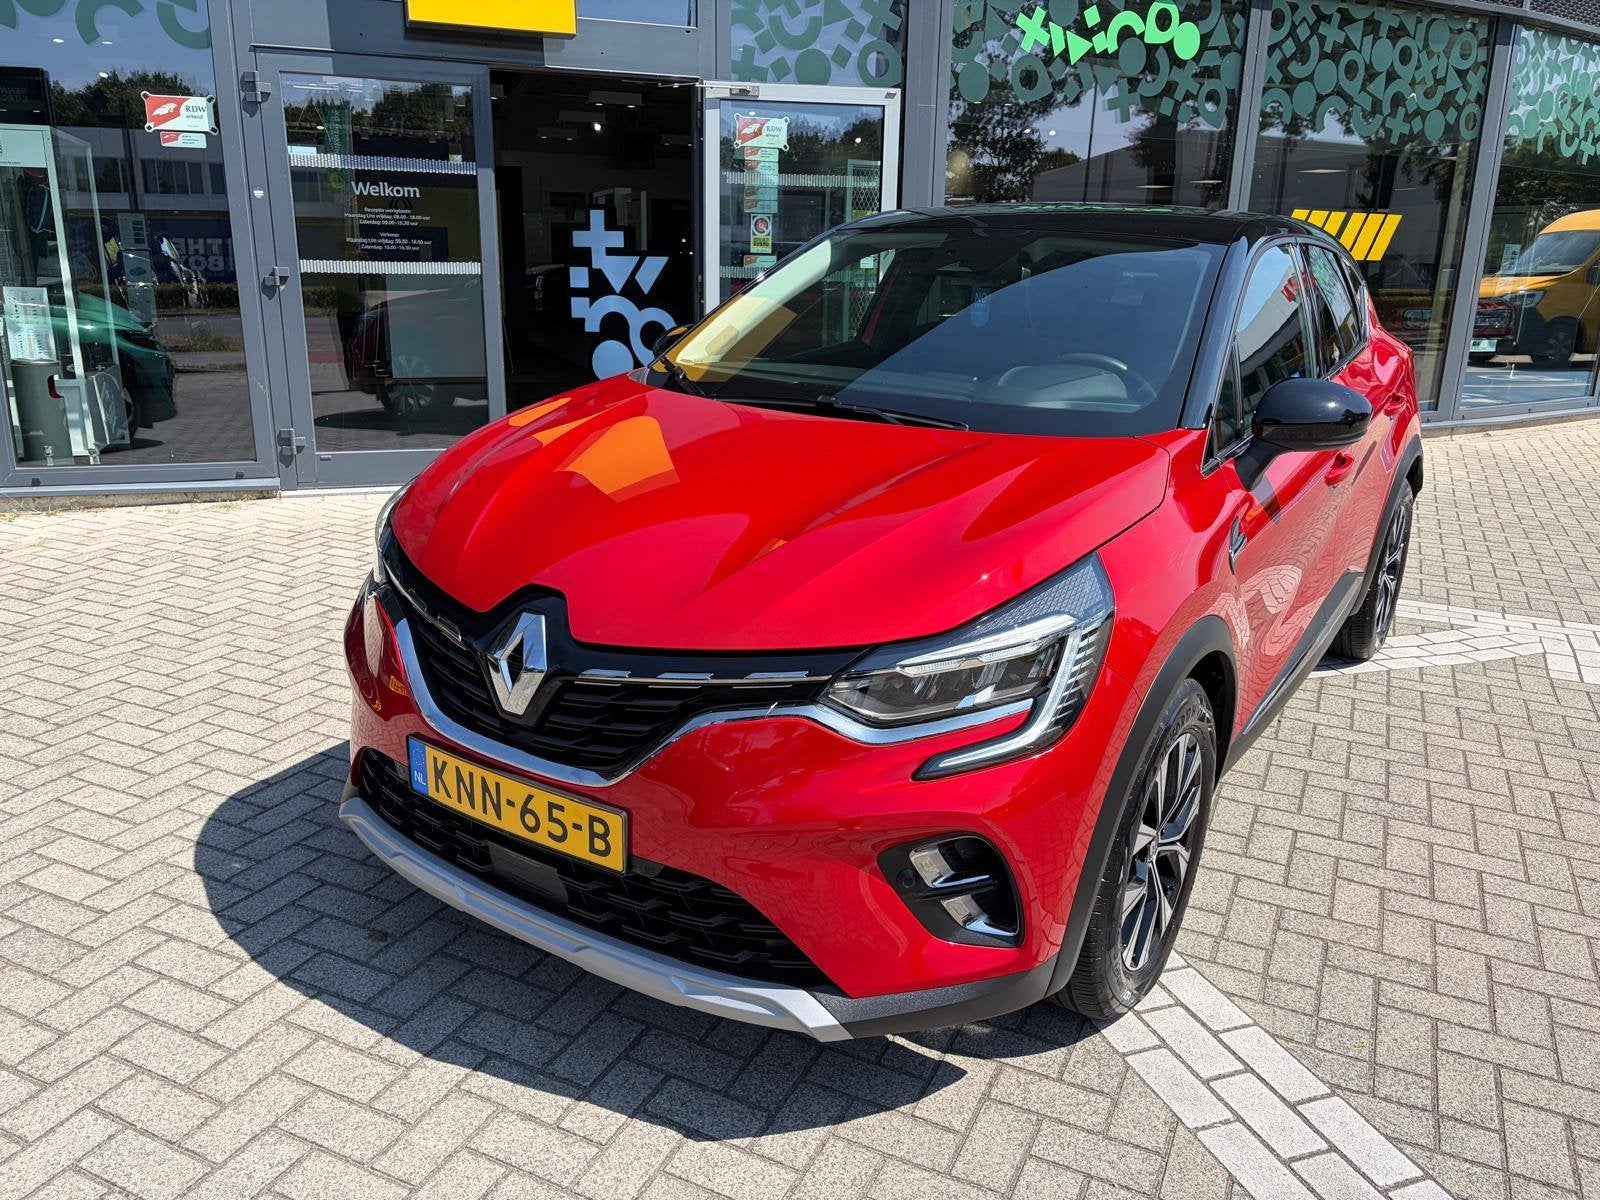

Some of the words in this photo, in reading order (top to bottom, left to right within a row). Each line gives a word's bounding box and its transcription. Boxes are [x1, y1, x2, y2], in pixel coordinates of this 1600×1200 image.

[185, 105, 207, 113] RDW
[351, 181, 421, 198] Welkom
[414, 771, 426, 786] NL
[432, 756, 612, 858] KNN-65-B
